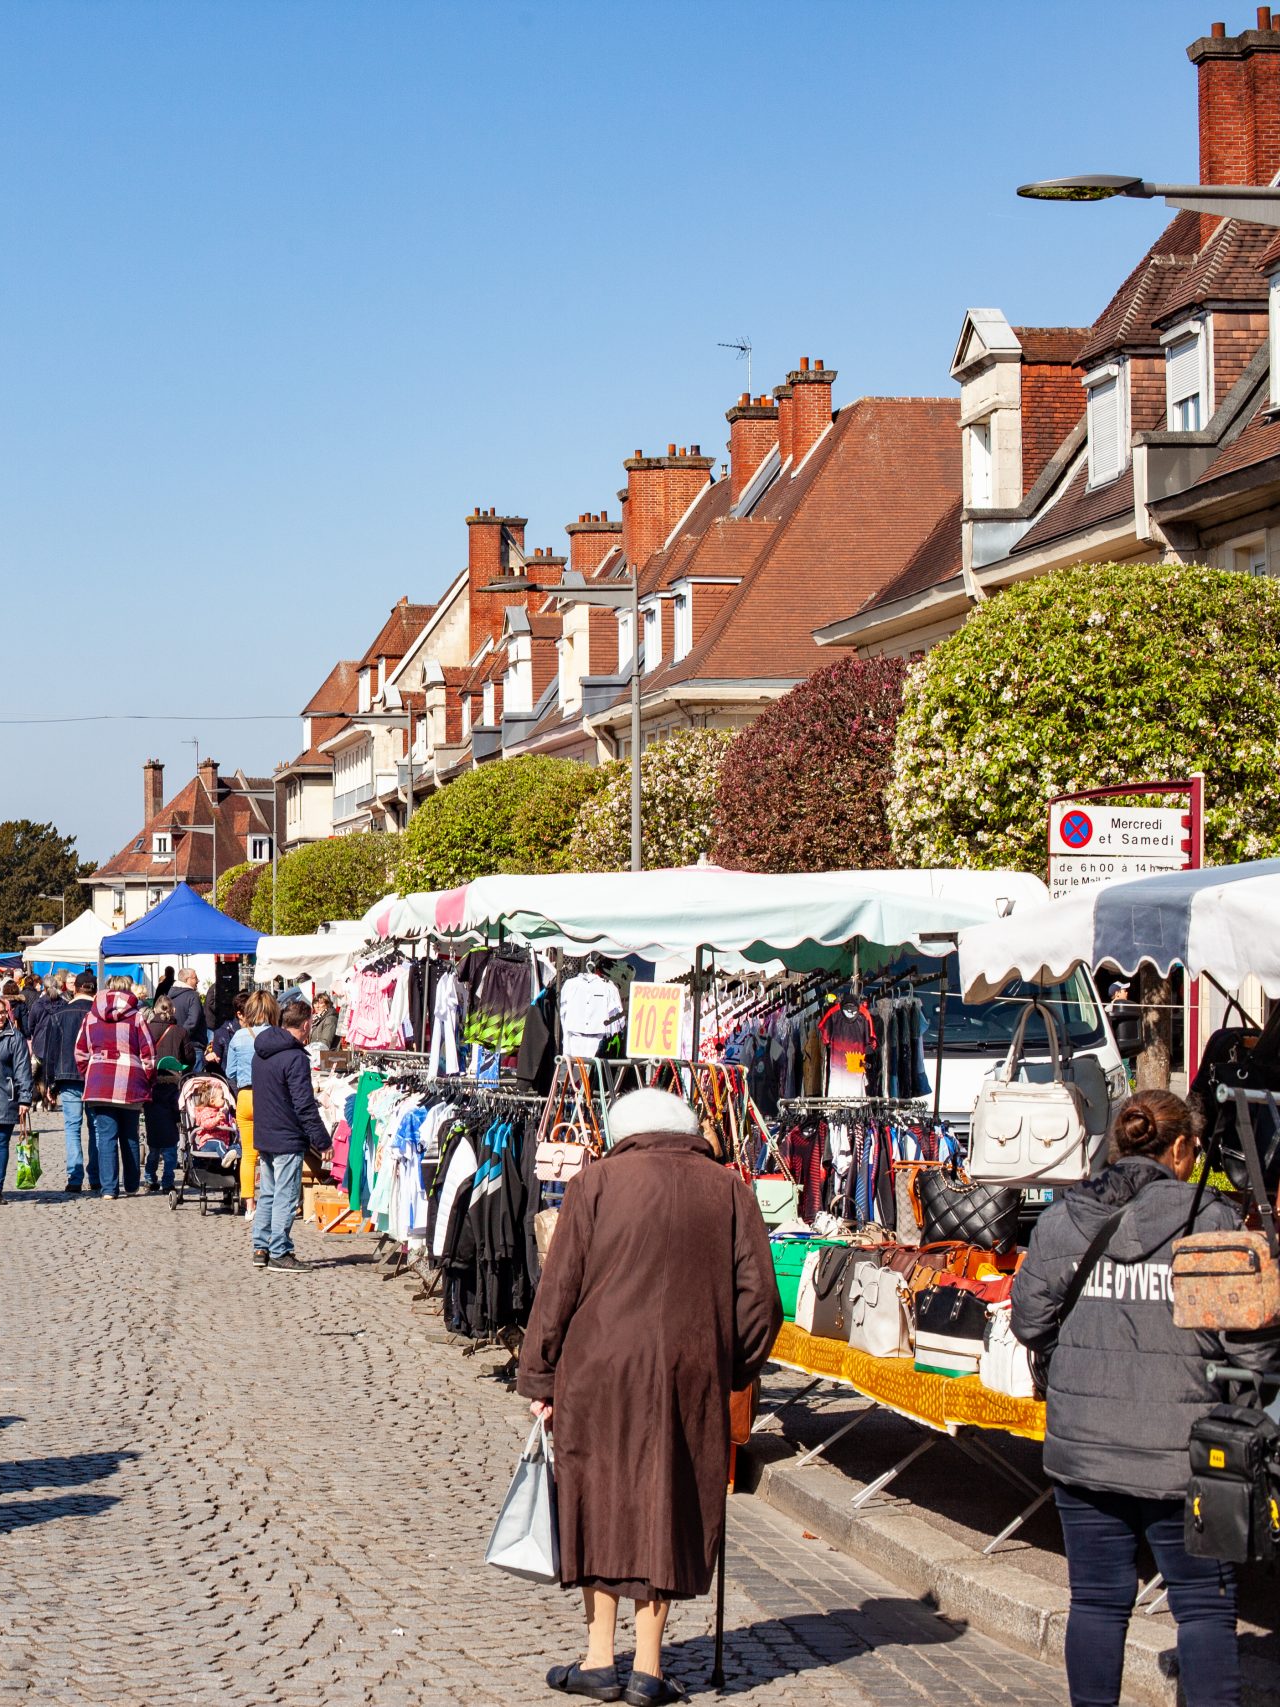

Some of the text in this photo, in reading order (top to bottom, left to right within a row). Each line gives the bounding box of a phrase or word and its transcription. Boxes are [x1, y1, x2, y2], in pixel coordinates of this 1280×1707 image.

[1110, 817, 1162, 831] Mercredi
[1099, 833, 1175, 846] et Samedi
[1059, 863, 1073, 872] de
[1053, 877, 1068, 886] sur
[1070, 876, 1079, 886] le
[633, 985, 681, 1001] PROMO
[635, 1004, 676, 1050] 10 €
